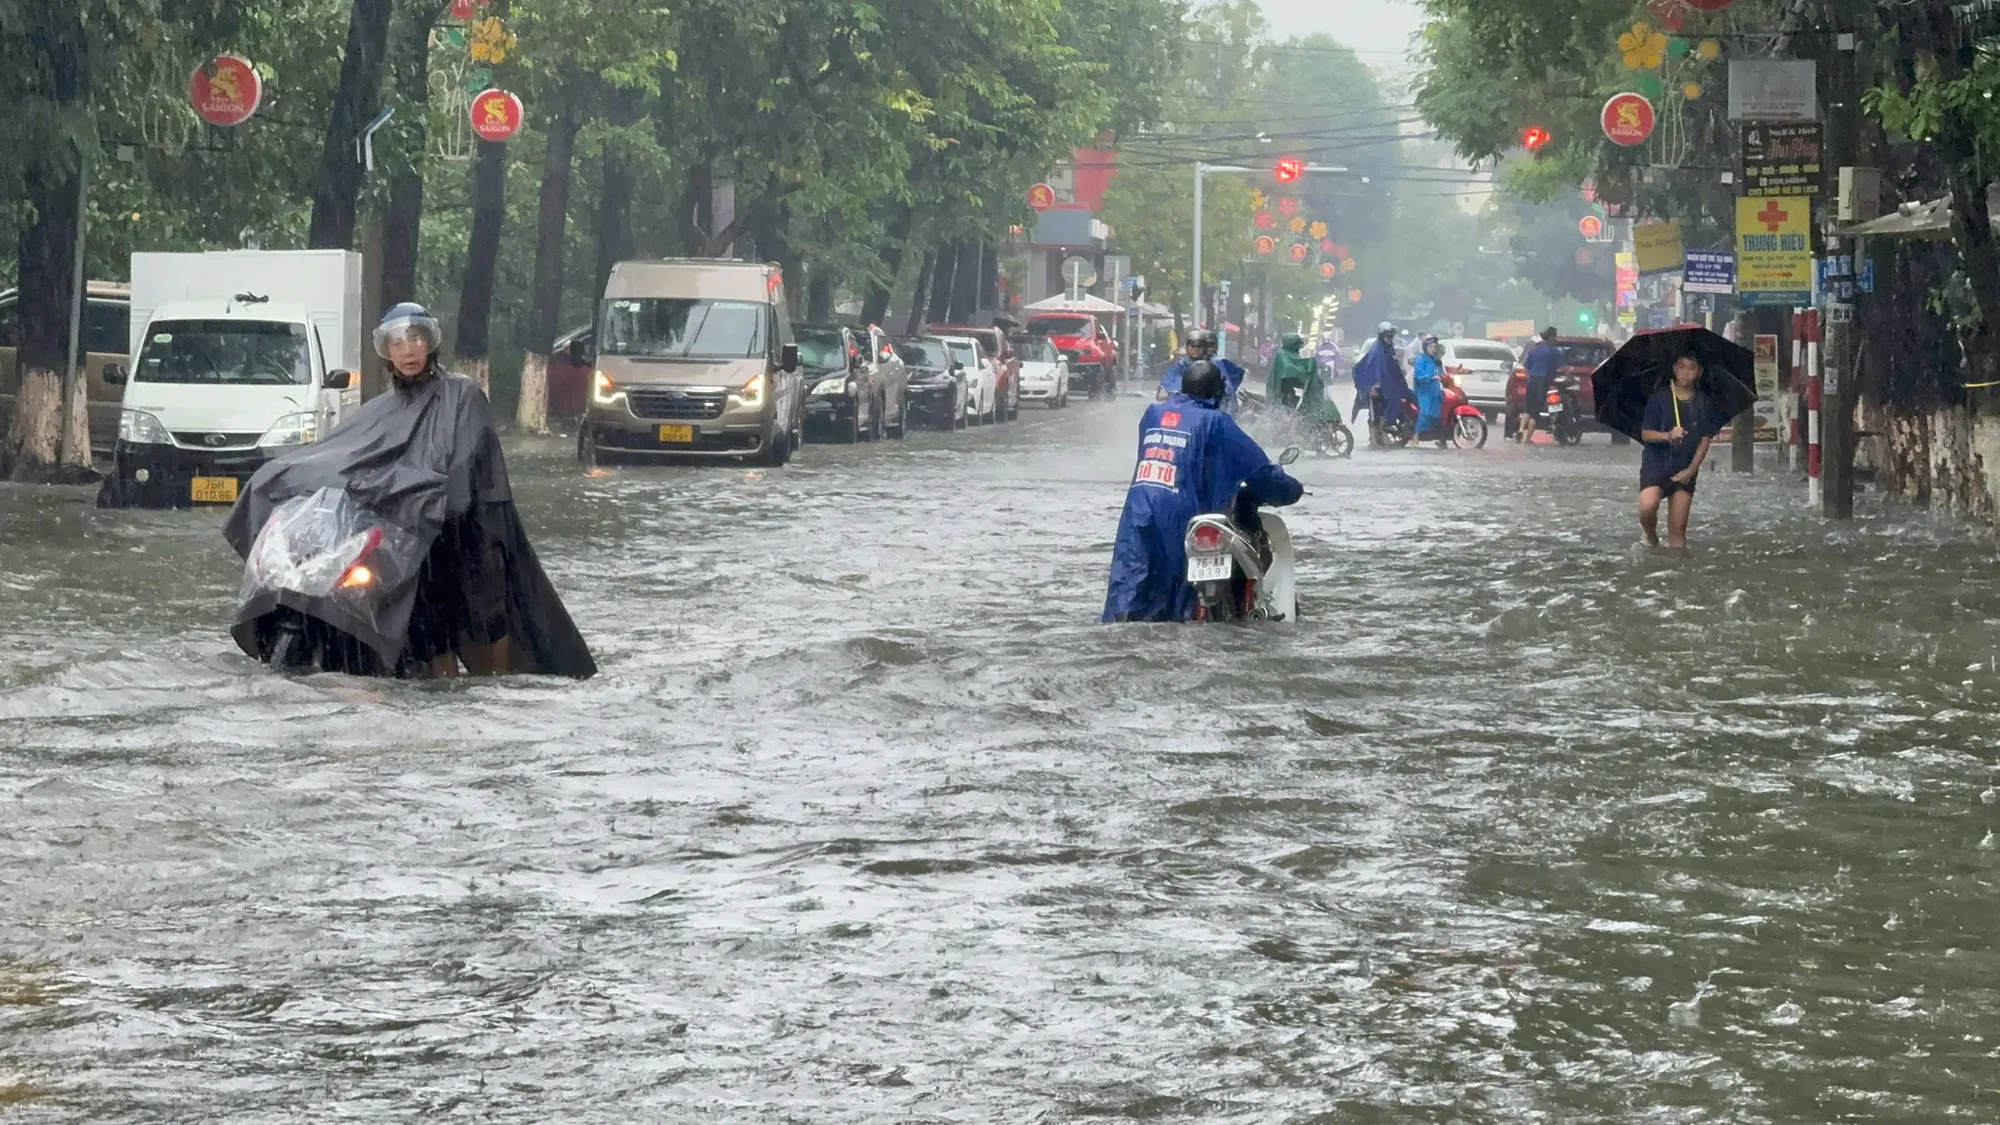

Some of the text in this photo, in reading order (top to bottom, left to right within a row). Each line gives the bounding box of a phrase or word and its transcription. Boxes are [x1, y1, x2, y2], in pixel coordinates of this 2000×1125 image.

[201, 103, 244, 113] SAIGON
[480, 124, 510, 132] SAIGON
[1610, 127, 1642, 136] SAIGON
[1743, 234, 1777, 251] TRUNG
[1138, 462, 1174, 483] TỪ TỪ
[205, 480, 225, 490] 76H
[1195, 556, 1225, 569] 76-AA
